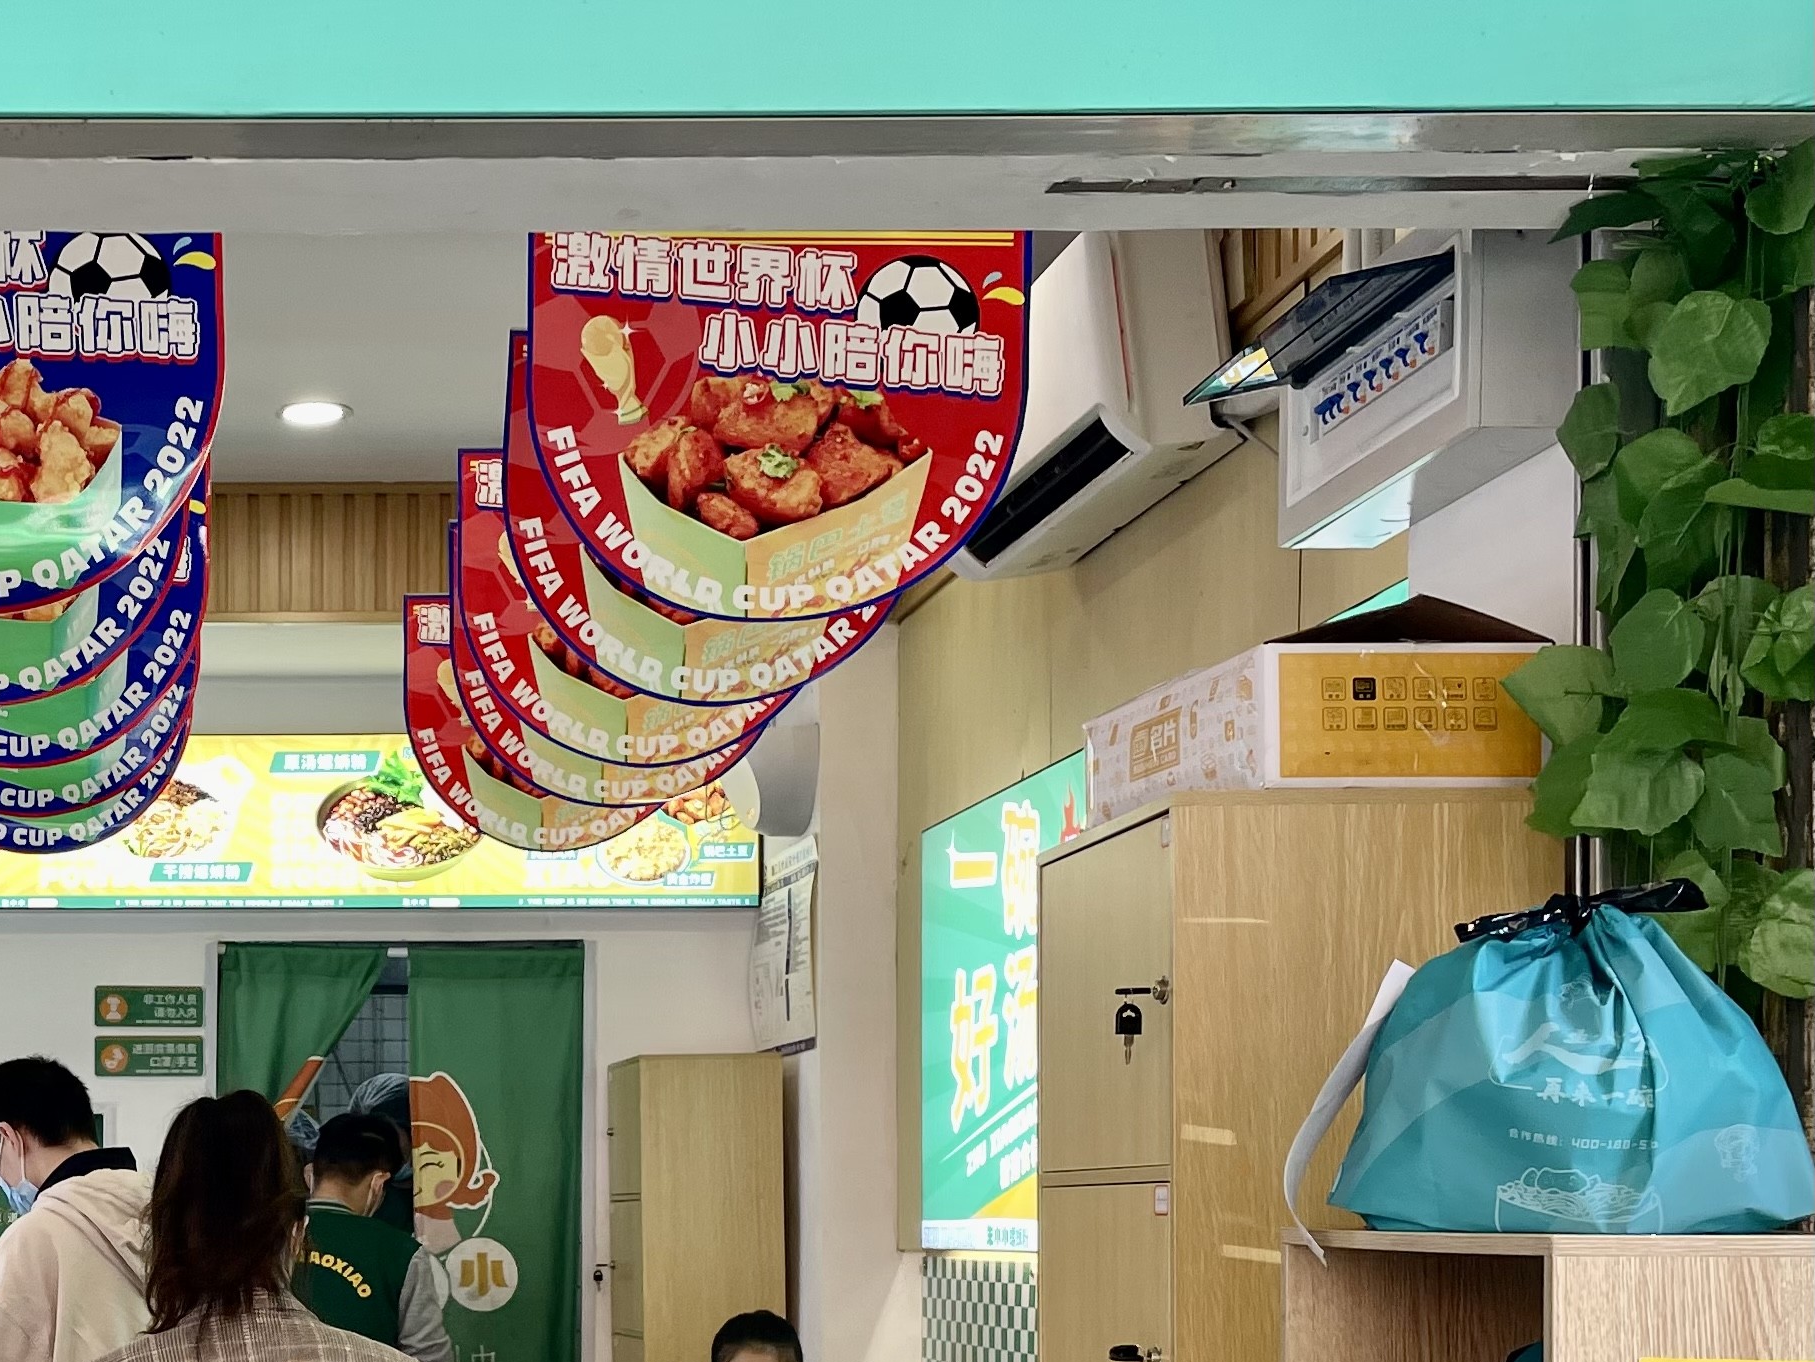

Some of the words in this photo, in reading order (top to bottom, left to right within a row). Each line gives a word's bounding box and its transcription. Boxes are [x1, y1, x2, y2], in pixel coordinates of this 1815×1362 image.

[554, 231, 857, 313] 激情世界杯
[700, 310, 1006, 396] 小小陪你嗨
[30, 492, 154, 591] QATAR
[143, 396, 203, 493] 2022
[545, 424, 604, 513] FIFA
[593, 511, 726, 608] WORLD
[731, 582, 818, 613] CUP
[822, 518, 950, 605] QATAR
[939, 428, 1005, 527] 2022
[18, 617, 127, 693] QATAR
[118, 538, 171, 622] 2022
[518, 516, 561, 602] FIFA
[555, 598, 665, 689] WORLD
[669, 665, 742, 693] CUP
[748, 619, 860, 689] QATAR
[56, 682, 150, 749] QATAR
[143, 607, 192, 682] 2022
[463, 669, 503, 741] FIFA
[497, 732, 588, 798] WORLD
[592, 776, 649, 800] CUP
[472, 611, 516, 695] FIFA
[510, 687, 610, 760] WORLD
[616, 731, 681, 758] CUP
[0, 786, 55, 808] CUP
[61, 745, 147, 805] QATAR
[141, 684, 186, 750] 2022
[415, 727, 455, 789] FIFA
[447, 781, 530, 846] WORLD
[532, 823, 585, 848] CUP
[11, 826, 63, 847] CUP
[68, 786, 145, 841] QATAR
[1536, 1077, 1654, 1109] 再来一碗
[459, 1252, 508, 1297] 小
